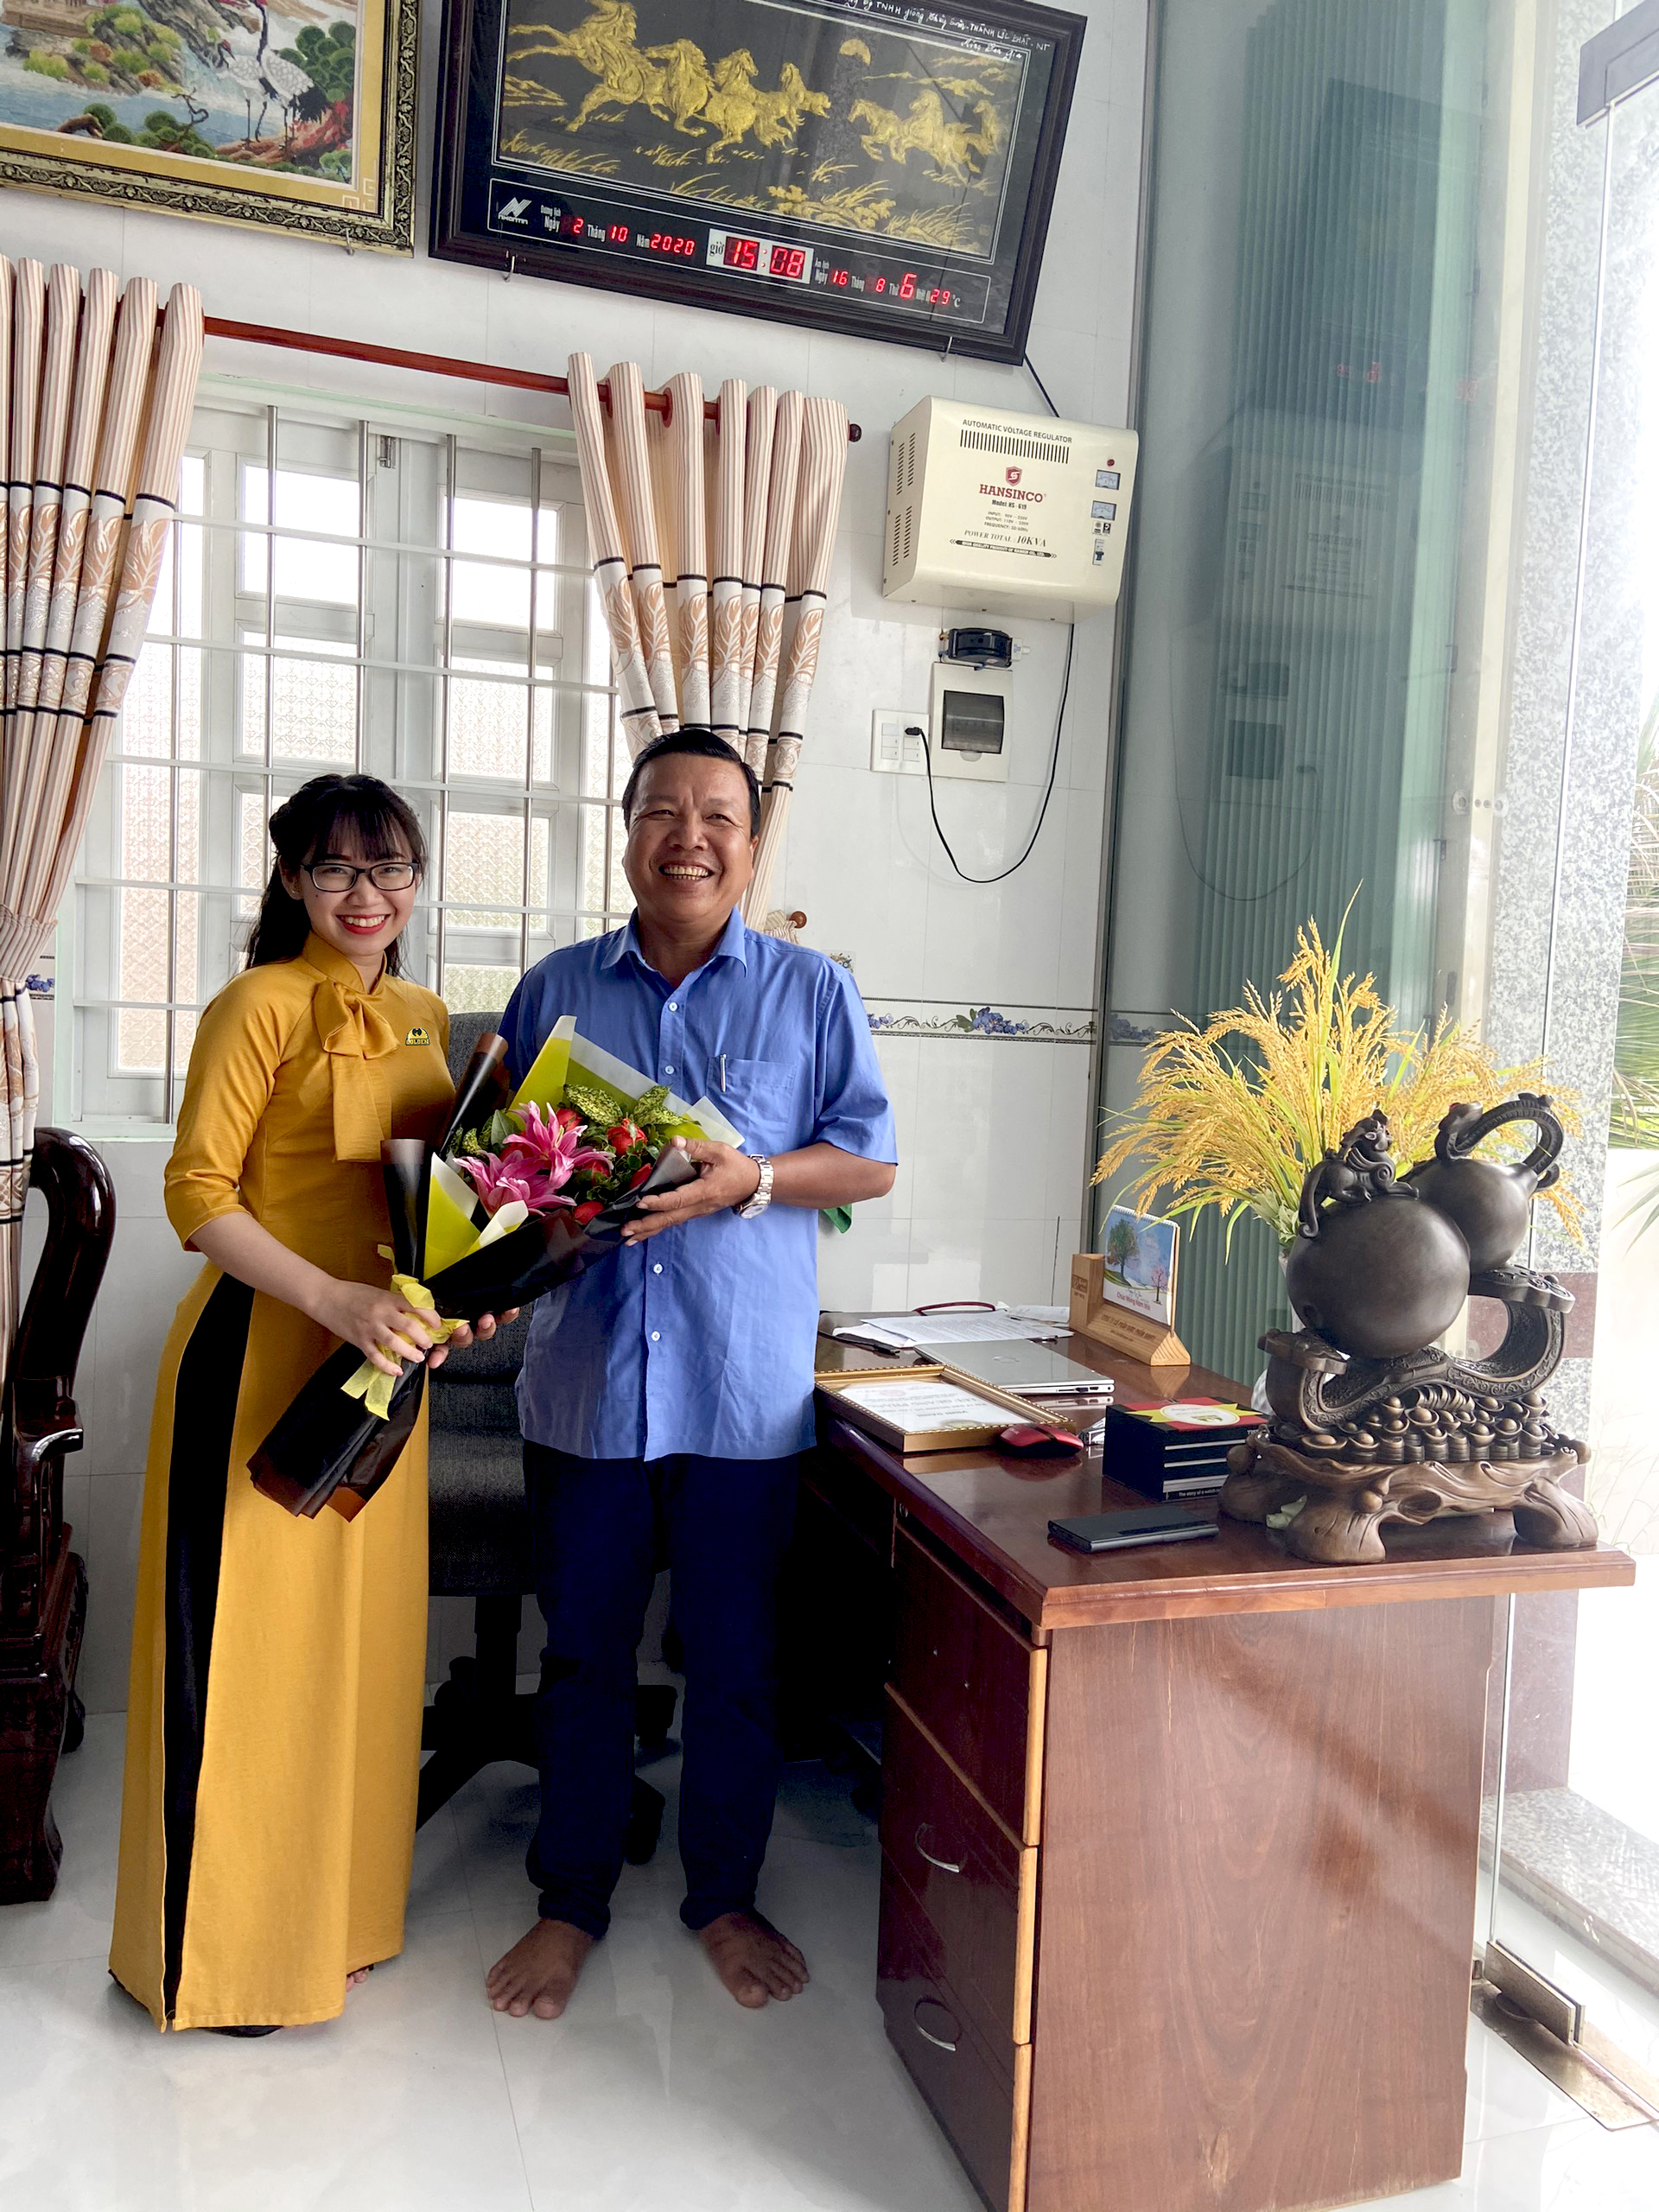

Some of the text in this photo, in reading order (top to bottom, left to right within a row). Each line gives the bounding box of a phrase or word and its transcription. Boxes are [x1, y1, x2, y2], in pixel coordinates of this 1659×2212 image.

[876, 1, 901, 14] TNHH
[544, 216, 695, 256] Ngày 2 Tháng 10 Năm 2020
[709, 242, 725, 257] giờ
[832, 270, 849, 285] 16
[875, 278, 886, 293] 8
[899, 272, 917, 298] 6
[930, 289, 950, 305] 29
[963, 419, 1072, 443] AUTOMATIC VOLTAGE REGULATOR
[979, 484, 1043, 503] HANSINCO
[964, 530, 989, 538] POWER
[1016, 535, 1046, 547] 10KVA
